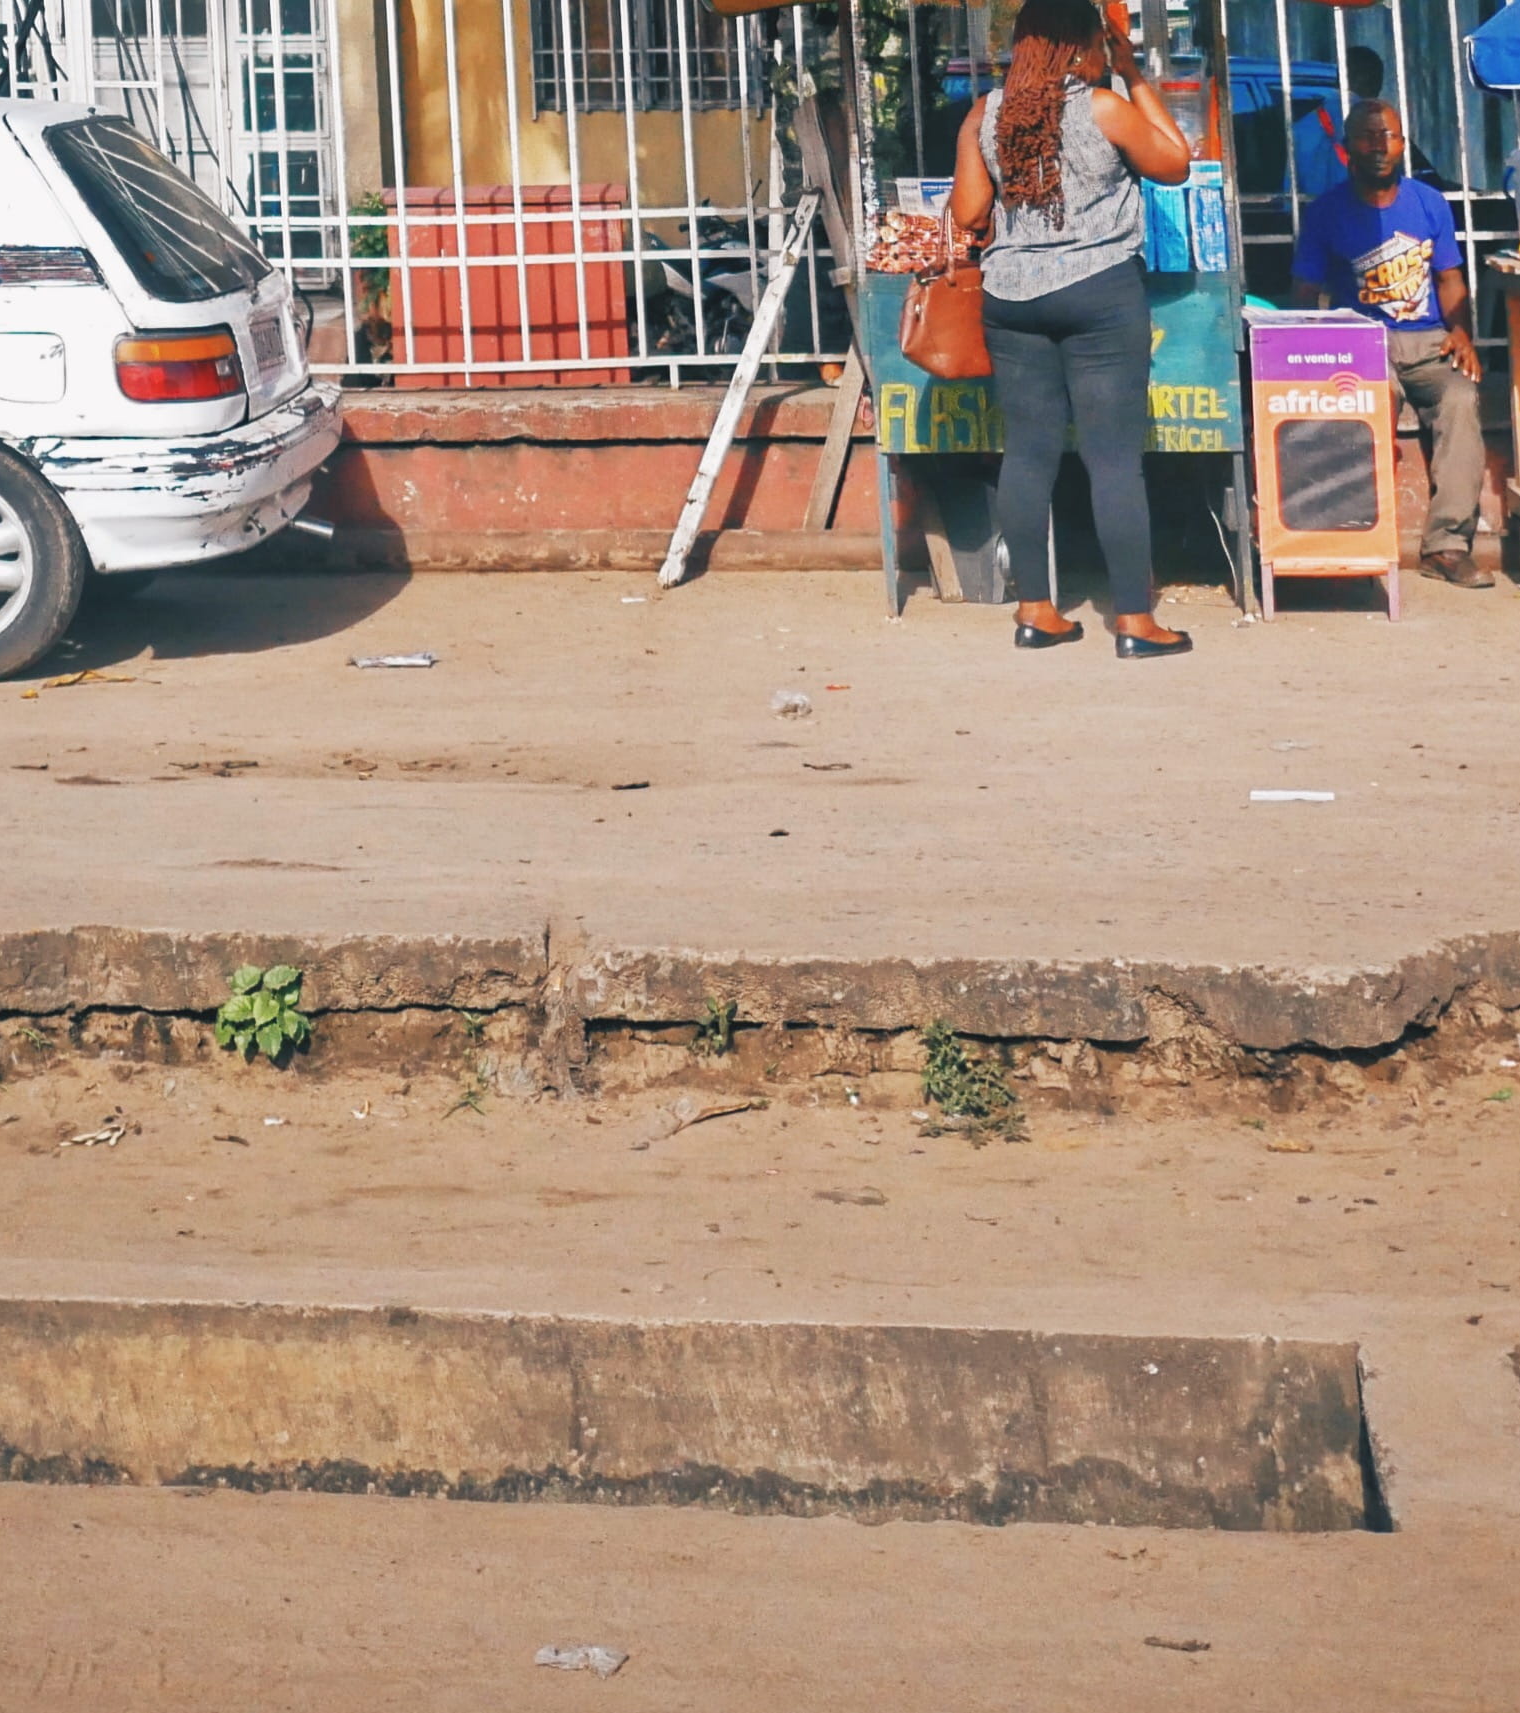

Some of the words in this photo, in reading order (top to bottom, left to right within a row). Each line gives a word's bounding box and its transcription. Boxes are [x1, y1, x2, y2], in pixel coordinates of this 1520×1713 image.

[1287, 354, 1301, 364] en
[1304, 354, 1336, 364] vente
[1338, 352, 1352, 364] ici
[1268, 389, 1375, 413] africell
